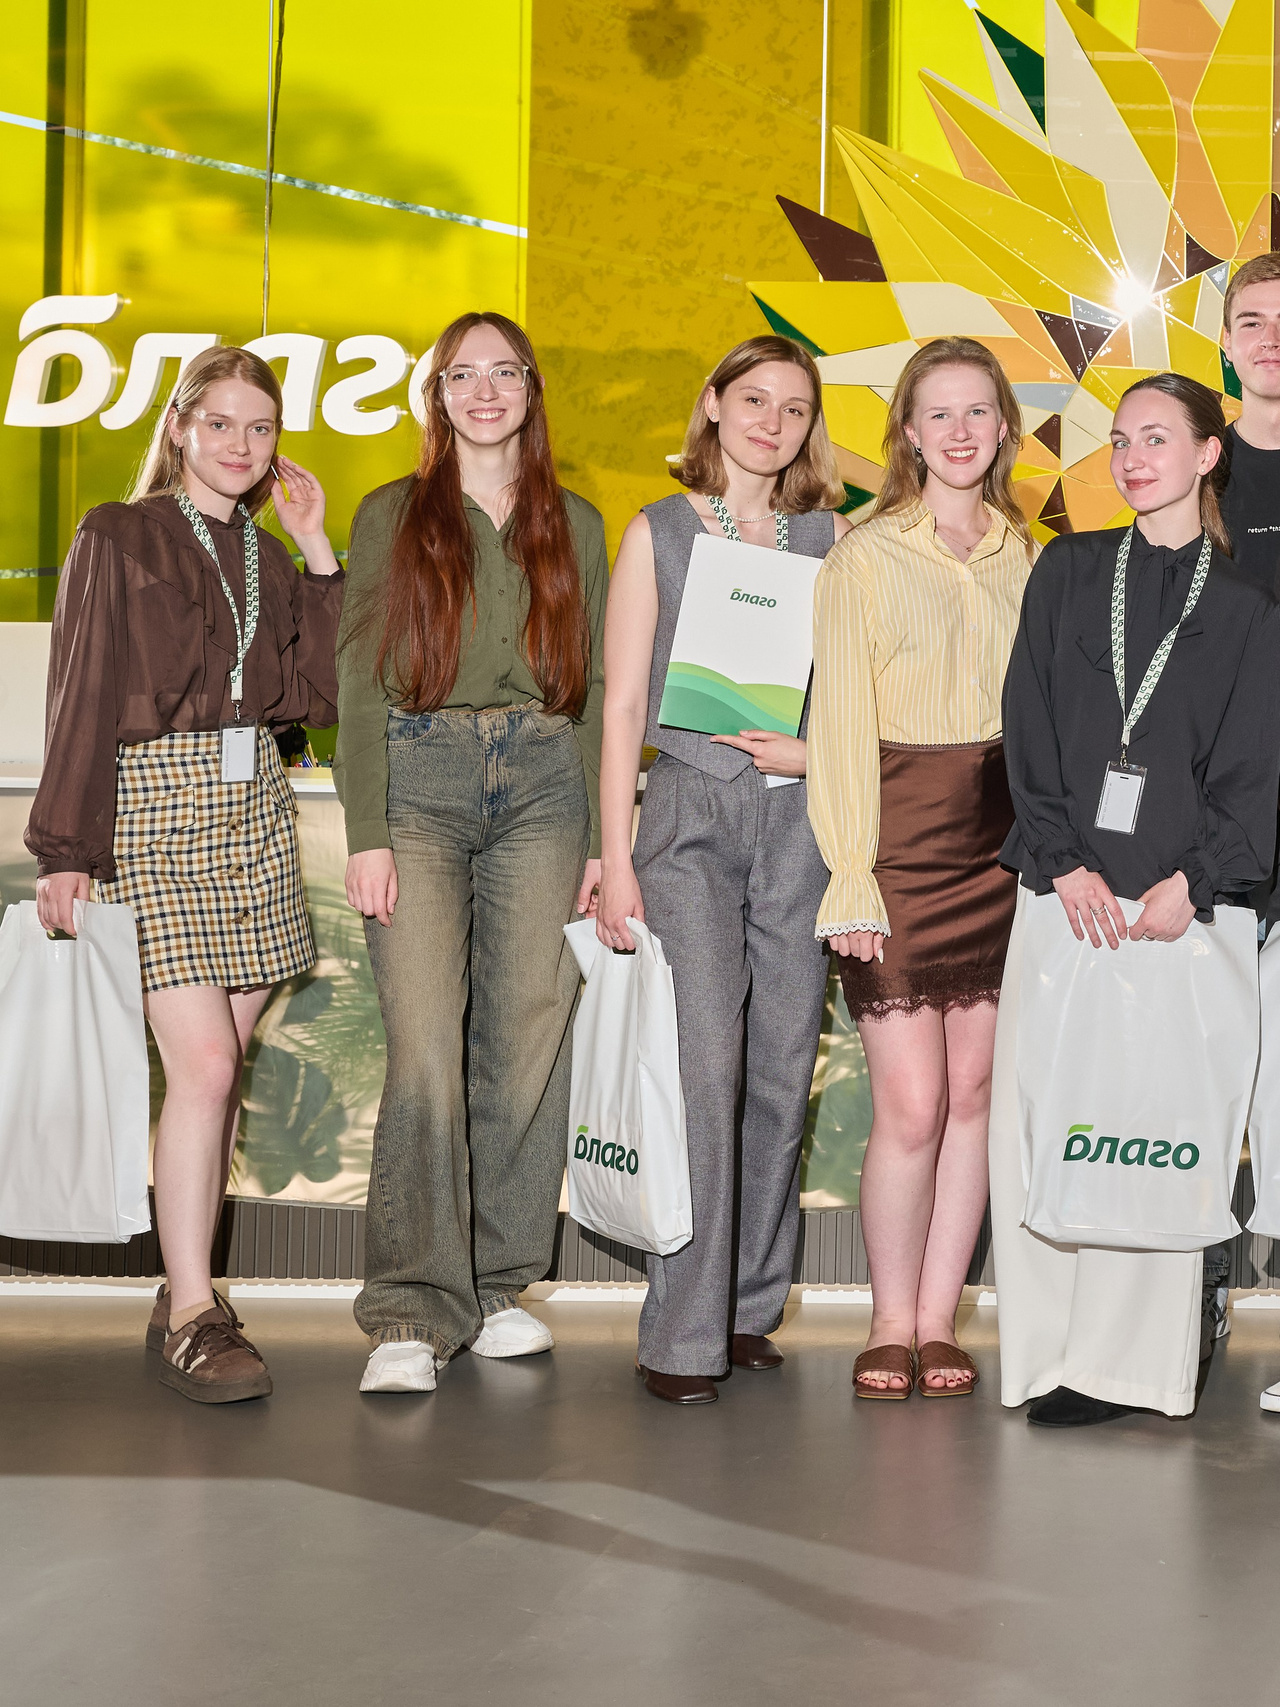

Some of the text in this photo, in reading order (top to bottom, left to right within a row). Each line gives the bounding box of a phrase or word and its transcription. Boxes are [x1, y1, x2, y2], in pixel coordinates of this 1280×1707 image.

[3, 292, 434, 436] благ
[729, 587, 777, 609] благо
[573, 1124, 639, 1176] благо
[1062, 1123, 1200, 1170] благо
